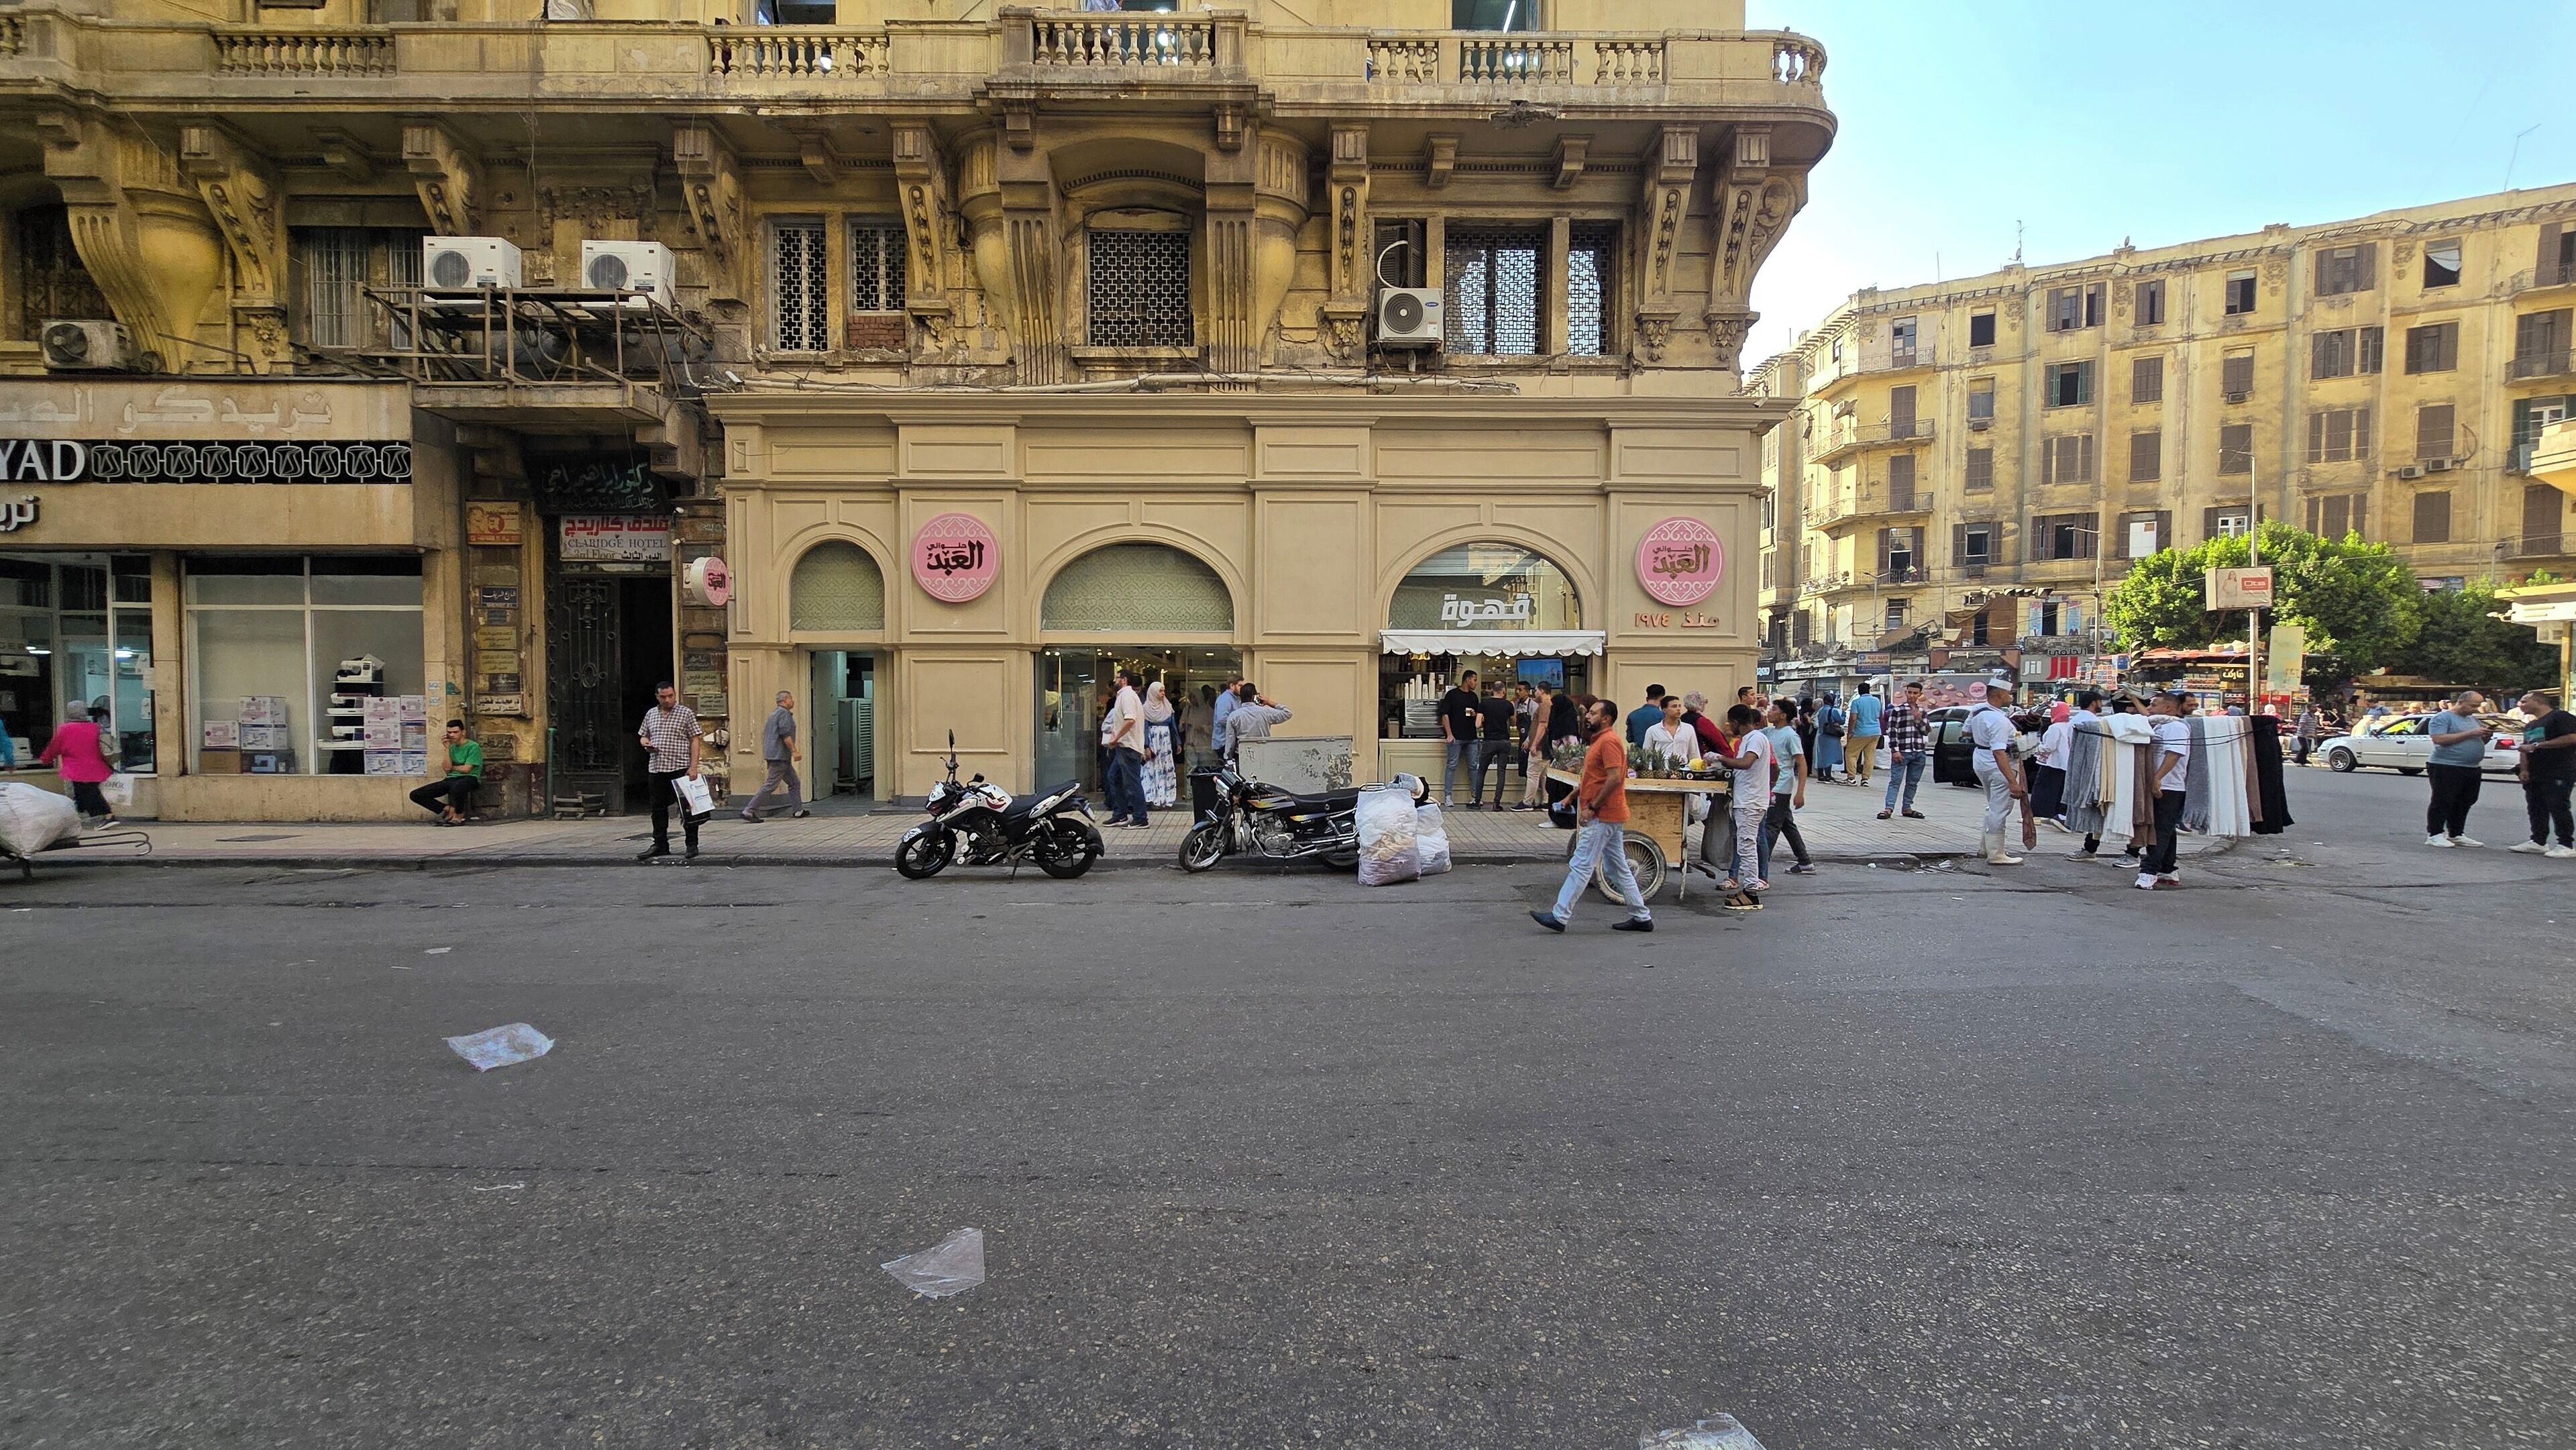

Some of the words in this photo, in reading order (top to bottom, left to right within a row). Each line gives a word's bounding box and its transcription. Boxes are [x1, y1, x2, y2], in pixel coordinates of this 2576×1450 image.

[568, 538, 623, 548] CLARIDGE
[629, 538, 667, 548] HOTEL
[592, 550, 616, 559] Floor
[1441, 593, 1530, 627] قهوة
[1635, 612, 1670, 628] ١٩٧٤
[1680, 611, 1719, 628] منذ
[2021, 661, 2042, 676] Jil
